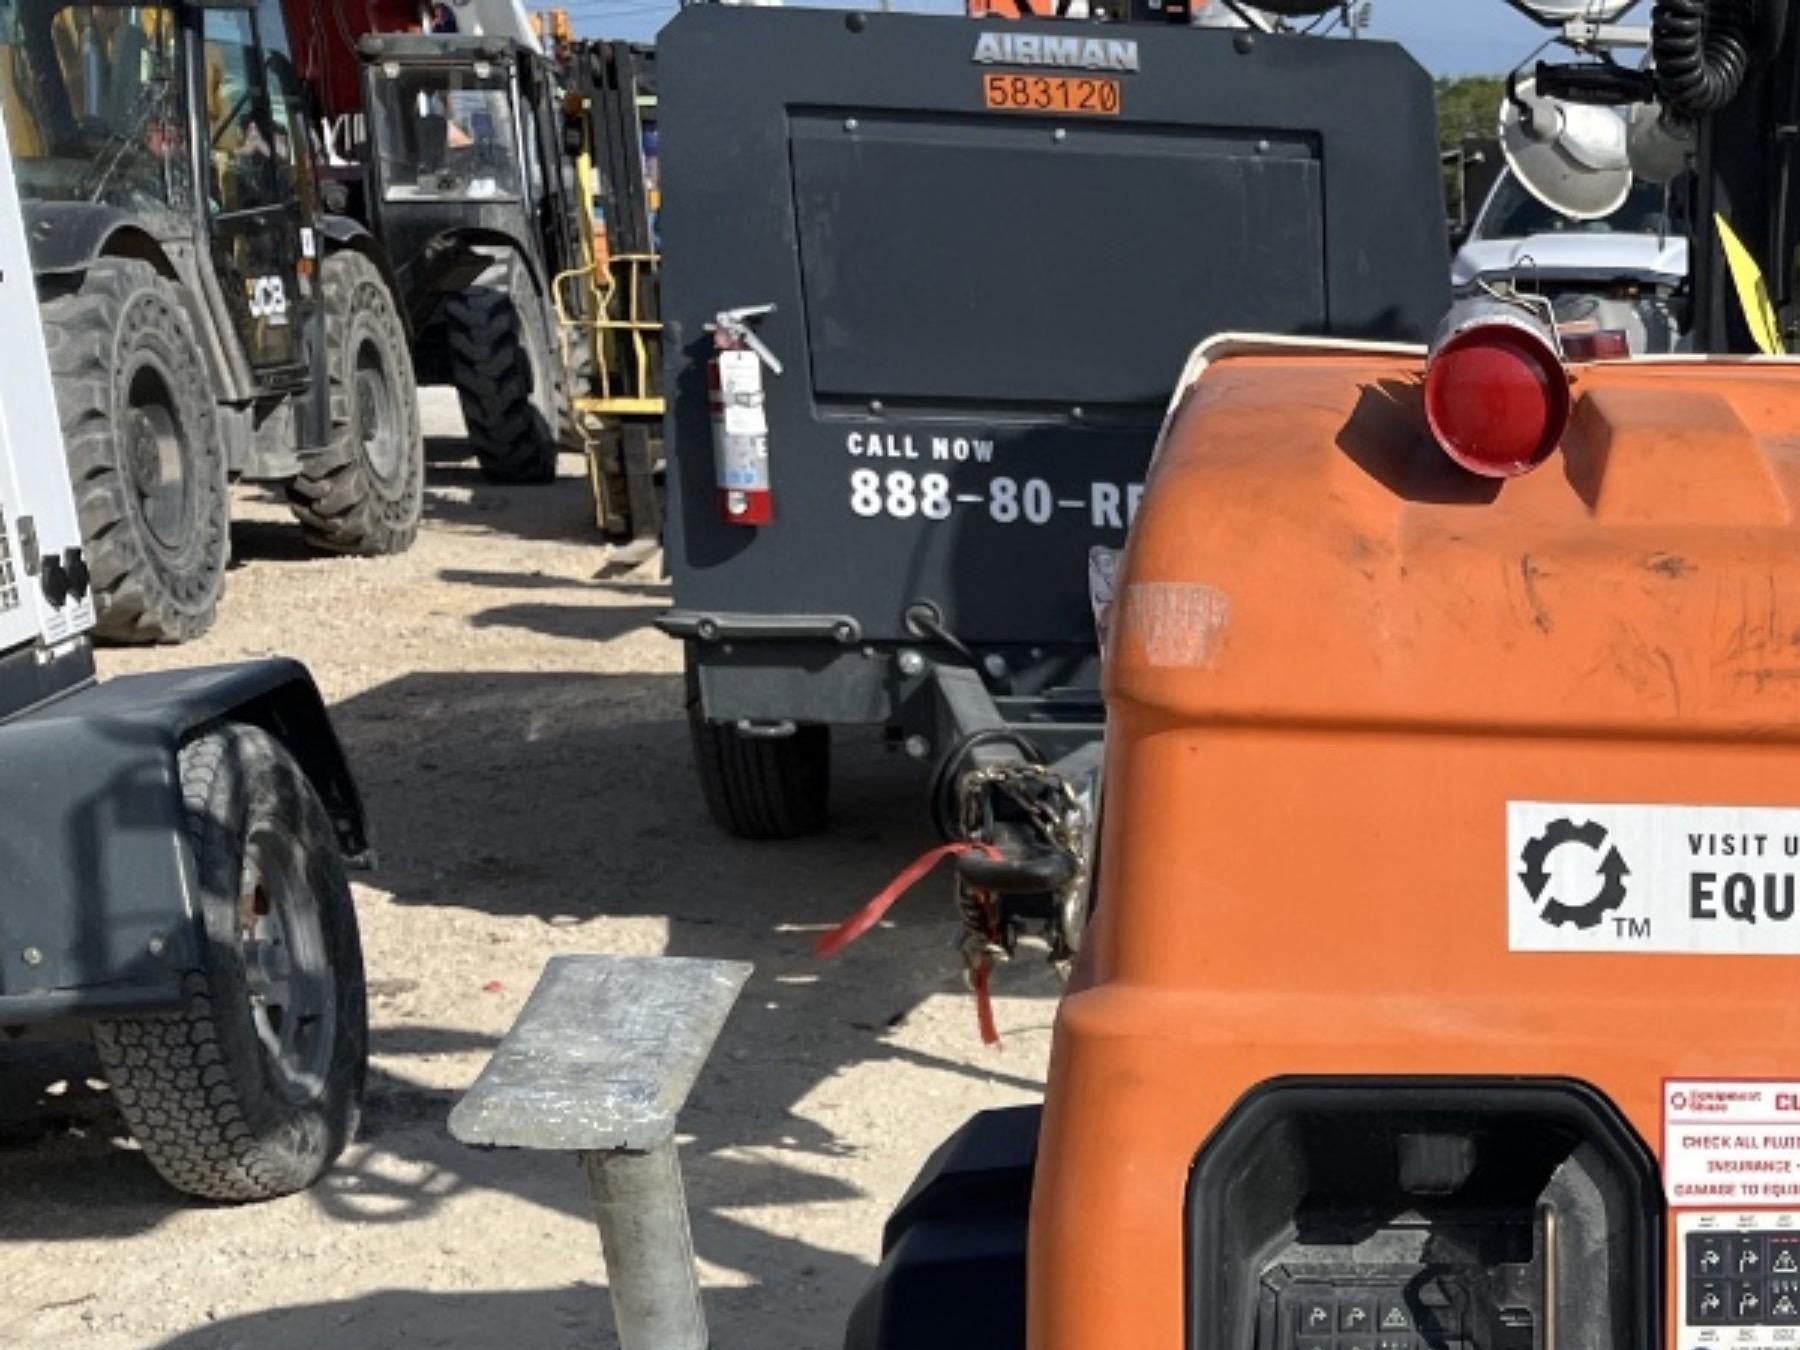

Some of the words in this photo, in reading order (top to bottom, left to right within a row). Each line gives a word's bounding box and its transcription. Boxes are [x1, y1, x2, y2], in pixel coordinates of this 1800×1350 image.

[973, 32, 1139, 71] AIRMAN
[988, 76, 1118, 112] 583120
[846, 431, 920, 458] CALL
[932, 437, 994, 463] NOW
[1688, 832, 1769, 856] VISIT
[1682, 1135, 1731, 1150] CHECK
[1734, 1135, 1759, 1150] ALL
[1706, 1160, 1792, 1174] INSURANCE
[1740, 1183, 1759, 1198] TO
